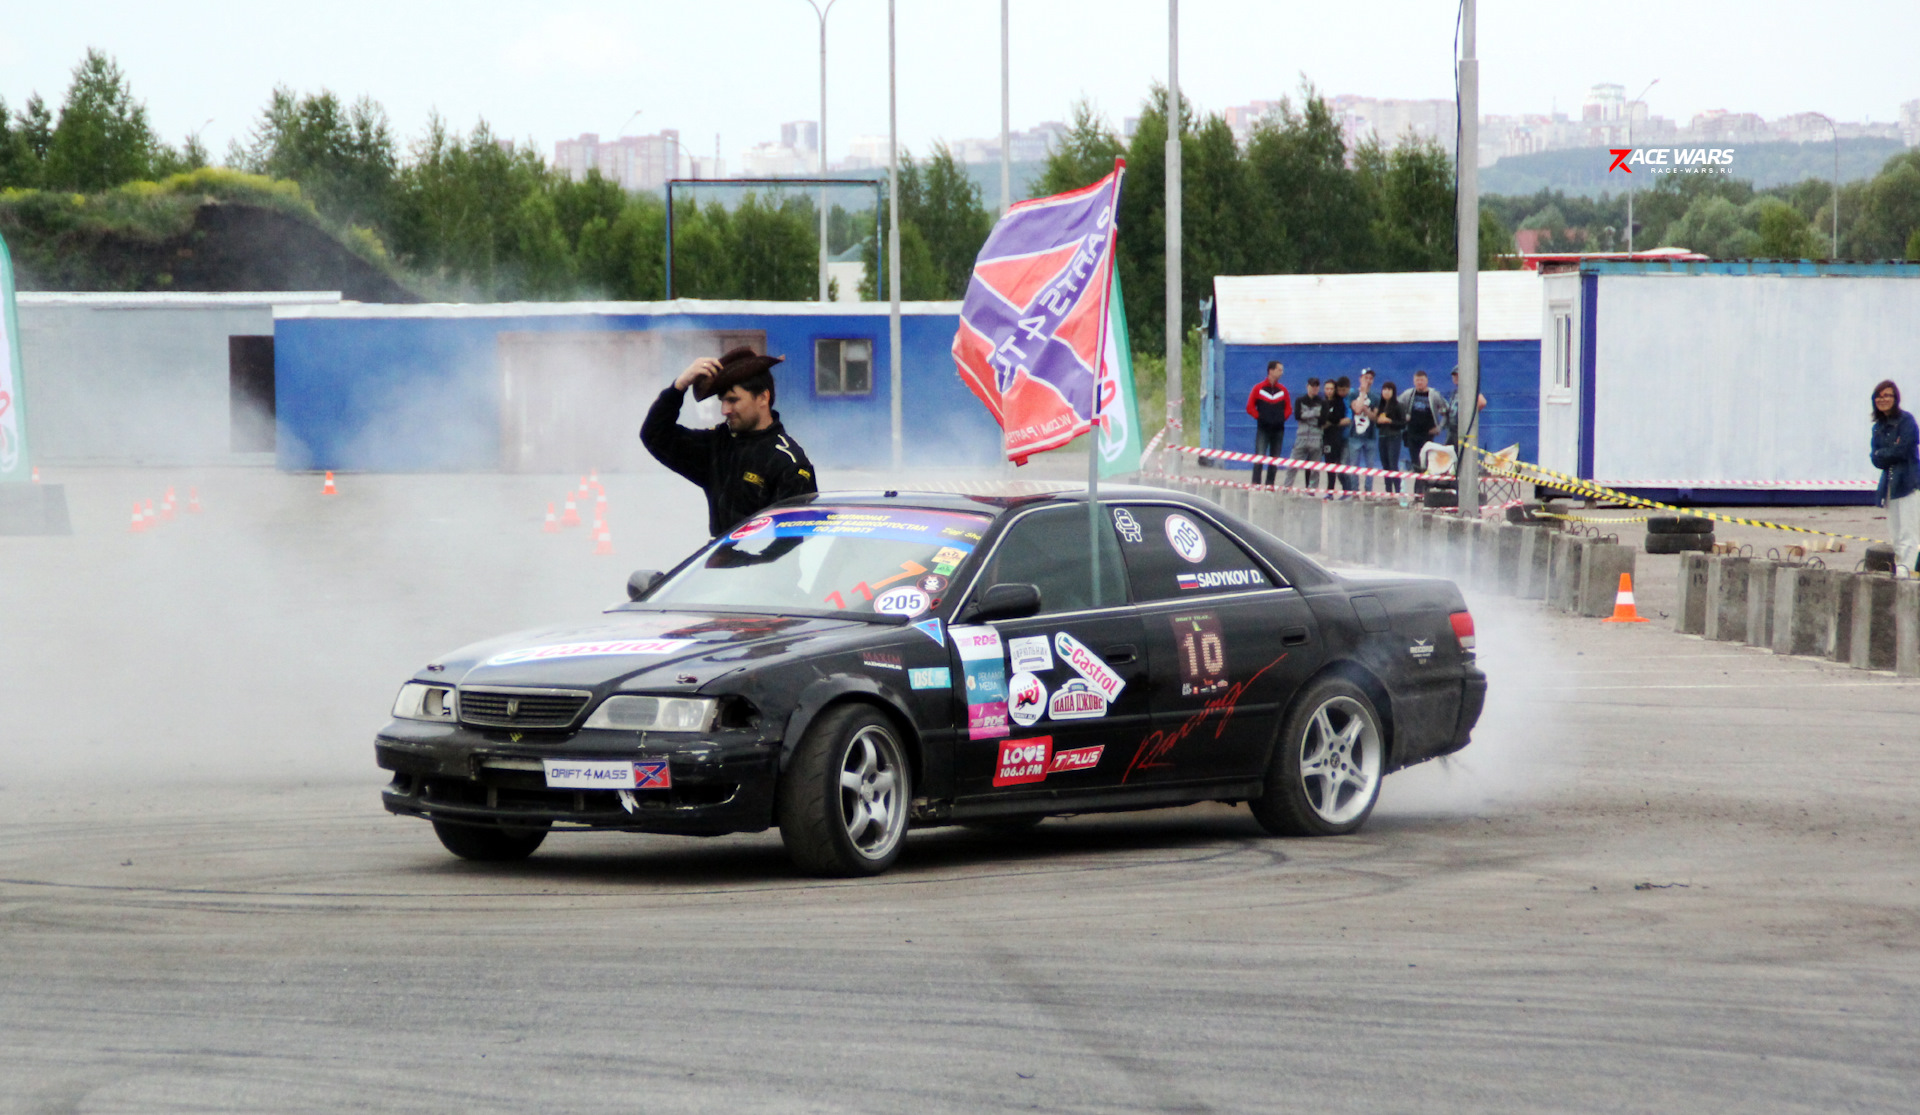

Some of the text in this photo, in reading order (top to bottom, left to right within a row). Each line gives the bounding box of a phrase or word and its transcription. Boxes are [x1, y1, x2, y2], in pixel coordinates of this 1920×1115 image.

[1174, 521, 1199, 556] 205
[1197, 569, 1264, 588] SADYKOV D.
[881, 594, 922, 611] 205
[973, 633, 997, 646] RDS
[535, 641, 680, 657] Castrol
[1183, 633, 1224, 676] 10
[914, 671, 934, 687] DSL
[1070, 648, 1118, 697] Castrol
[1054, 694, 1075, 712] ПАПА
[983, 715, 1006, 728] RDS
[551, 768, 582, 779] DRIFT
[583, 768, 593, 780] 4
[593, 769, 628, 780] MASS
[1000, 764, 1043, 778] 106.6 FM
